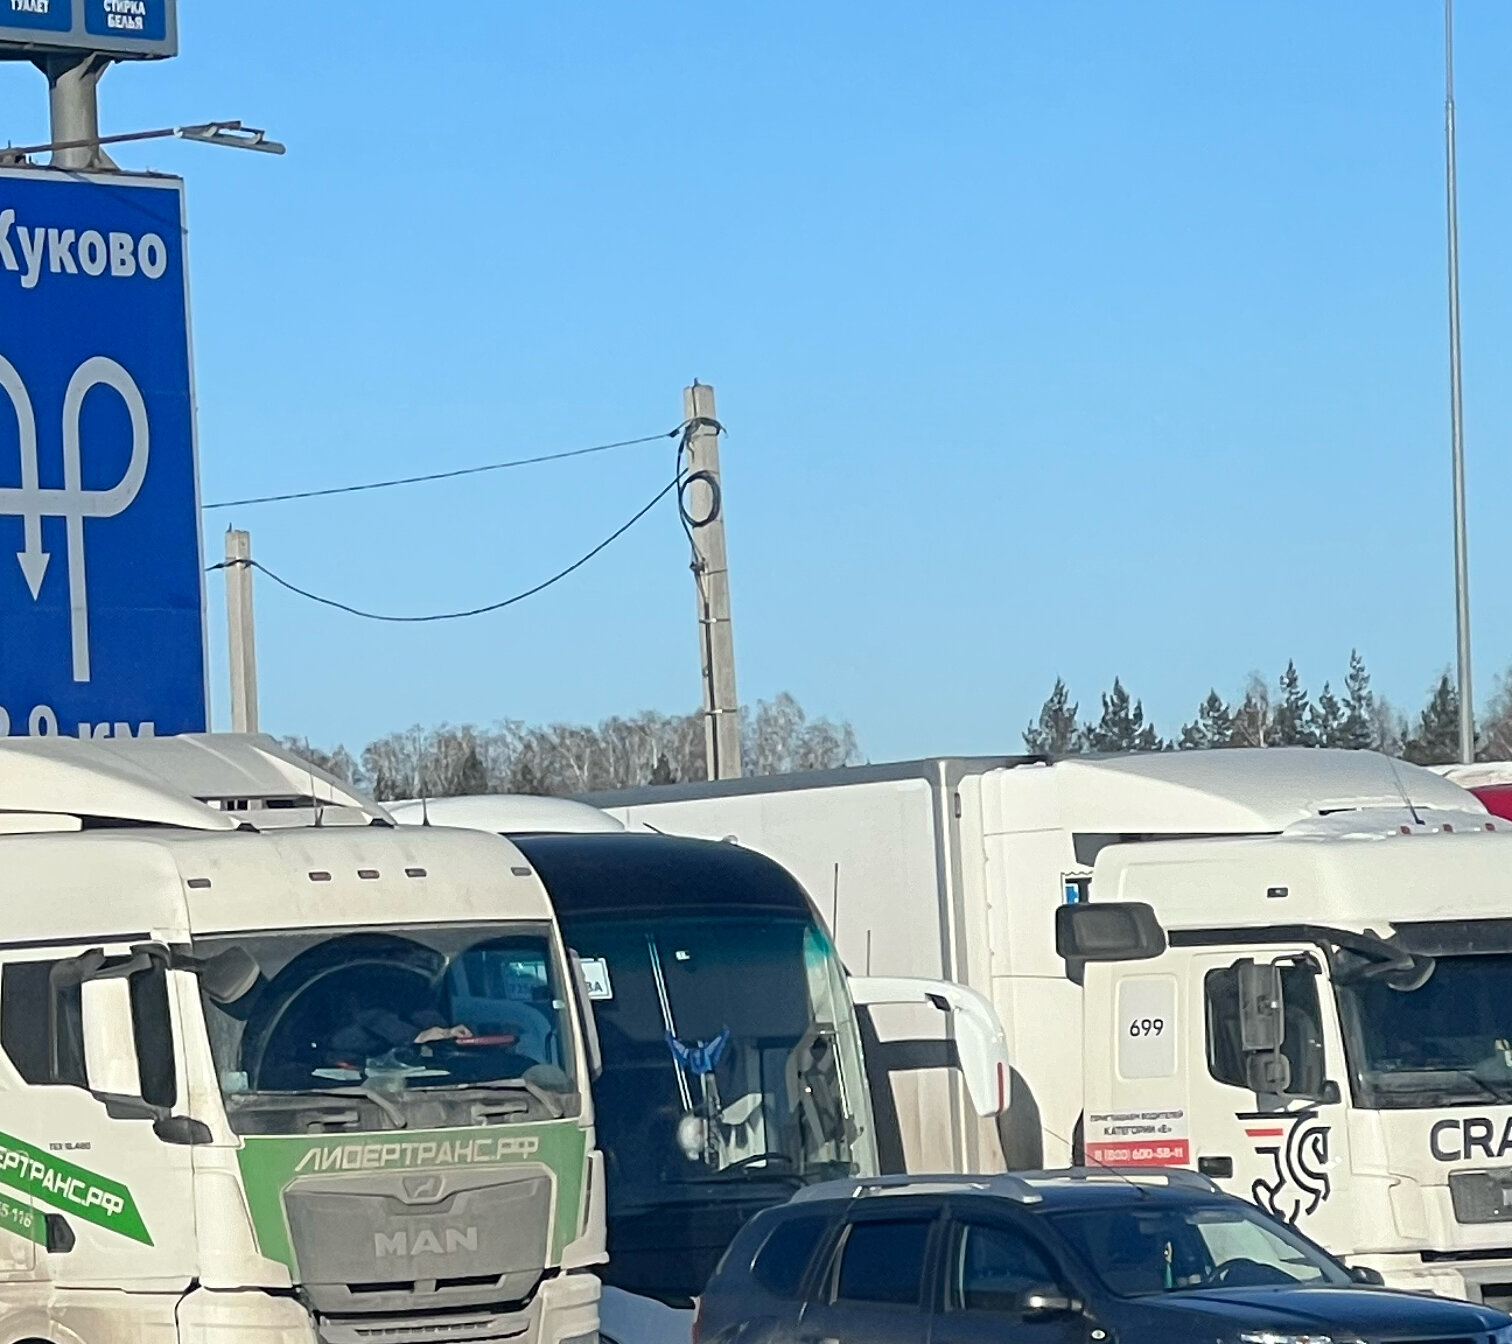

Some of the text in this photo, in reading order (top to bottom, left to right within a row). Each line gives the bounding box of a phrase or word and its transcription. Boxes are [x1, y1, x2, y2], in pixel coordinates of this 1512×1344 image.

[107, 12, 144, 30] БЕЛЬЯ
[1130, 1018, 1164, 1037] 699
[295, 1136, 539, 1171] ЛИДЕРТРАНС.РФ
[374, 1226, 478, 1257] MAN
